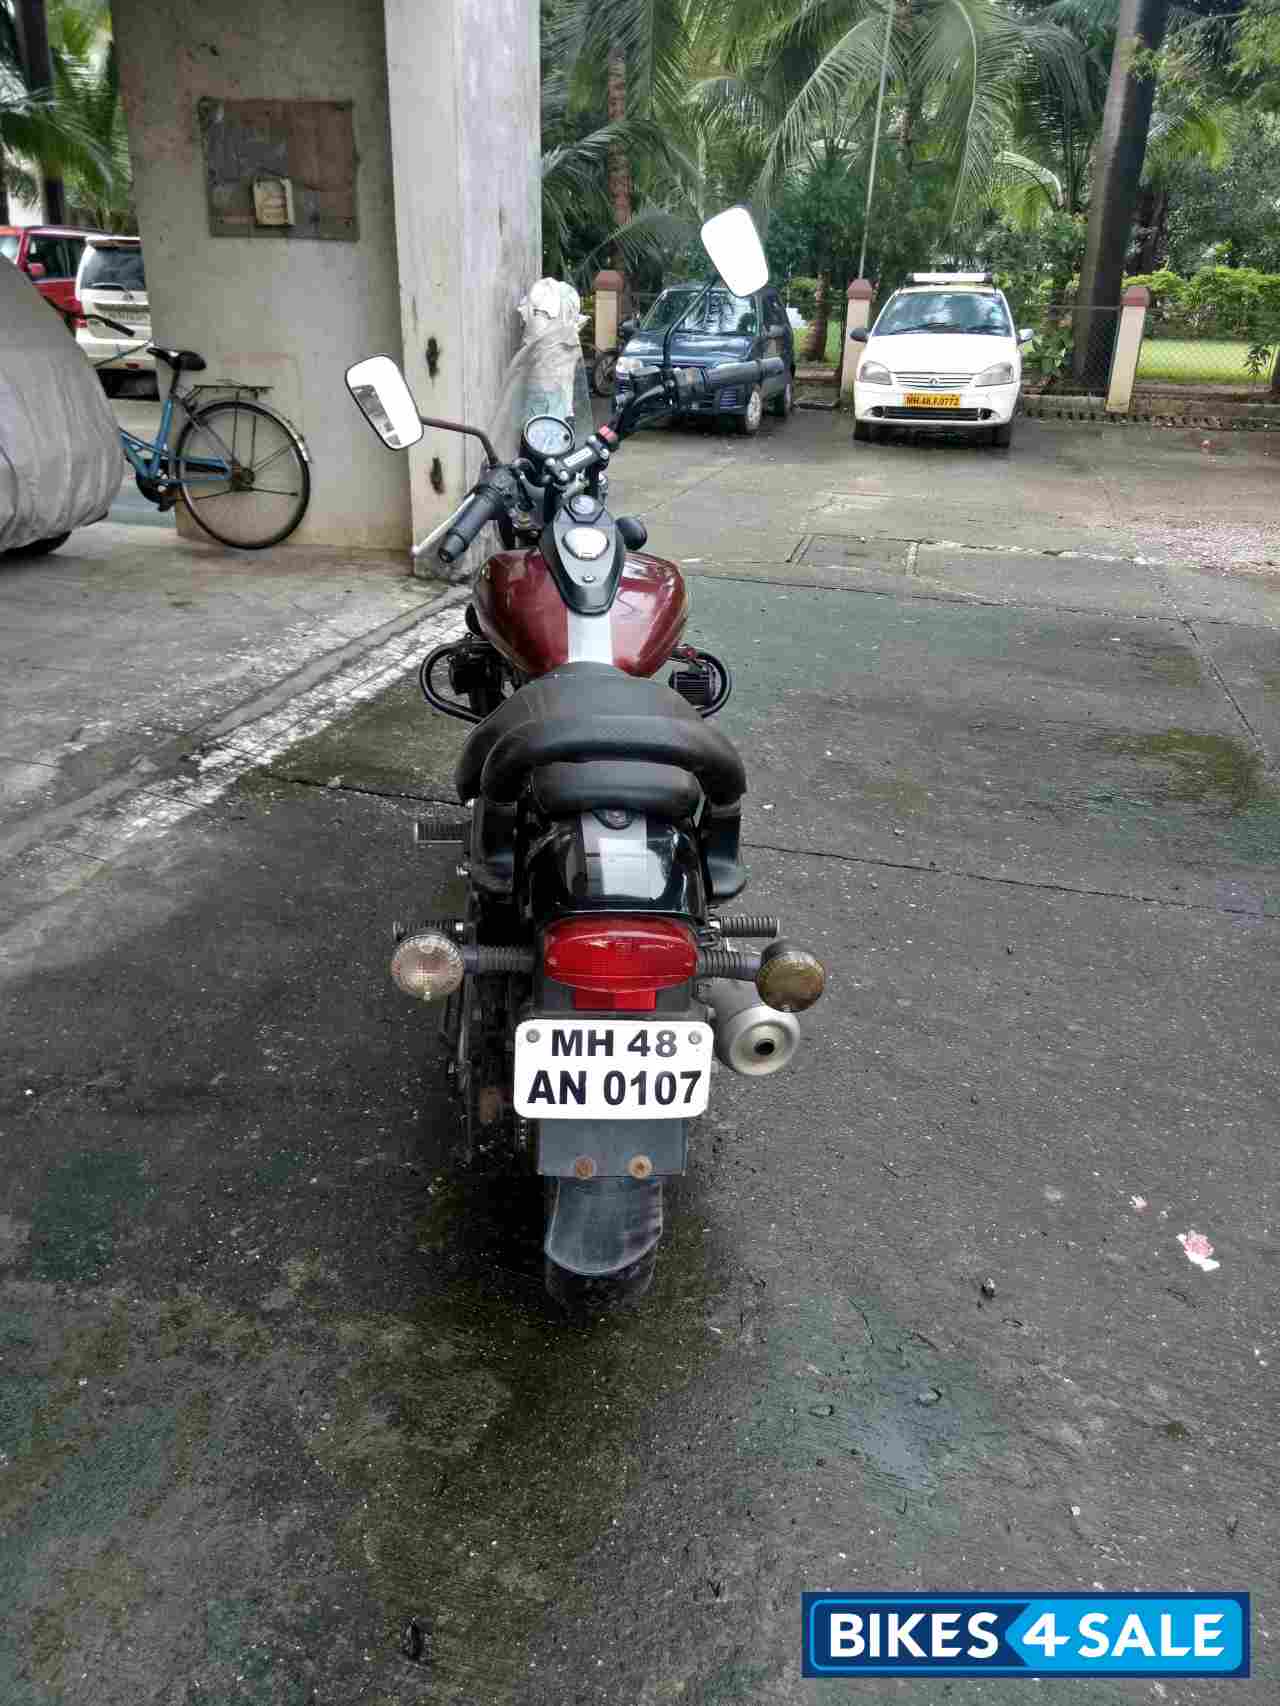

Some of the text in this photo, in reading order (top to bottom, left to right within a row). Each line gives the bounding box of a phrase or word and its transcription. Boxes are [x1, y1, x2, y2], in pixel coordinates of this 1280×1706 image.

[552, 1029, 678, 1057] MH 48
[527, 1069, 702, 1105] AN 0107
